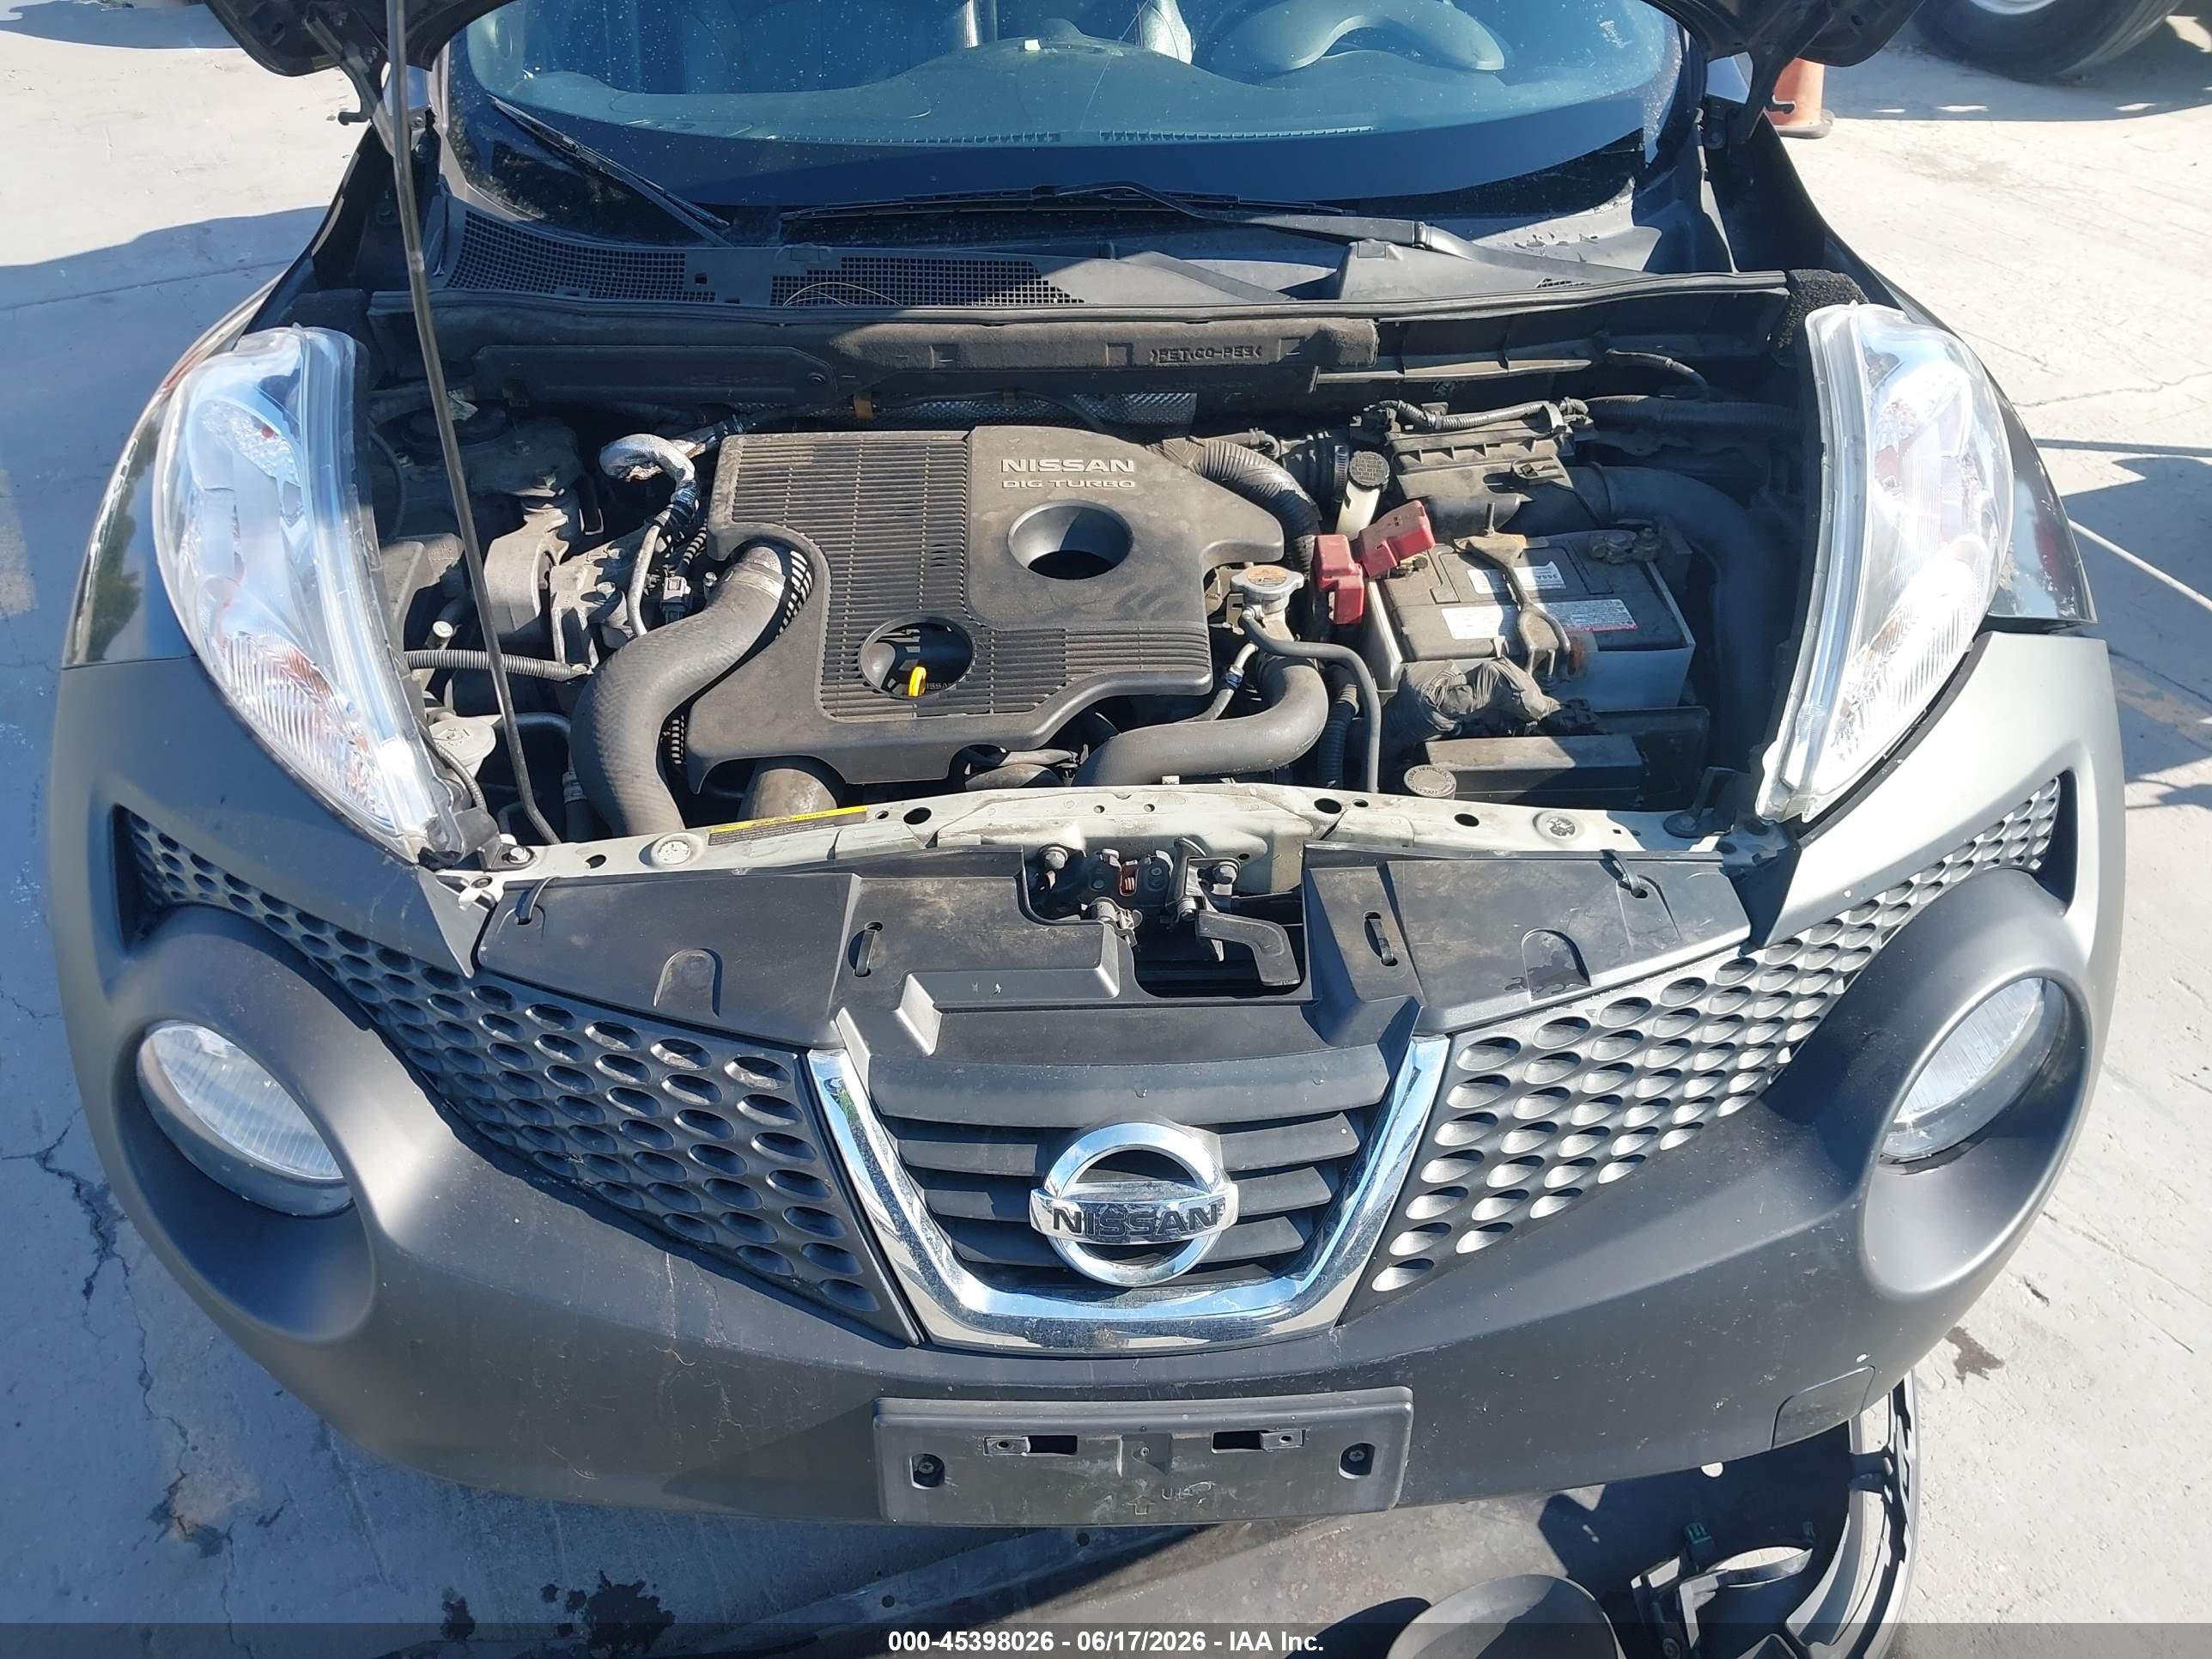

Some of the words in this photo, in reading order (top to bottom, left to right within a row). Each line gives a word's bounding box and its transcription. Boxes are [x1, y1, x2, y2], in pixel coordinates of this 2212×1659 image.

[1001, 458, 1135, 473] NISSAN
[1002, 480, 1043, 489] DIG
[1049, 479, 1136, 489] TURBO
[1053, 1204, 1218, 1237] NISSAN
